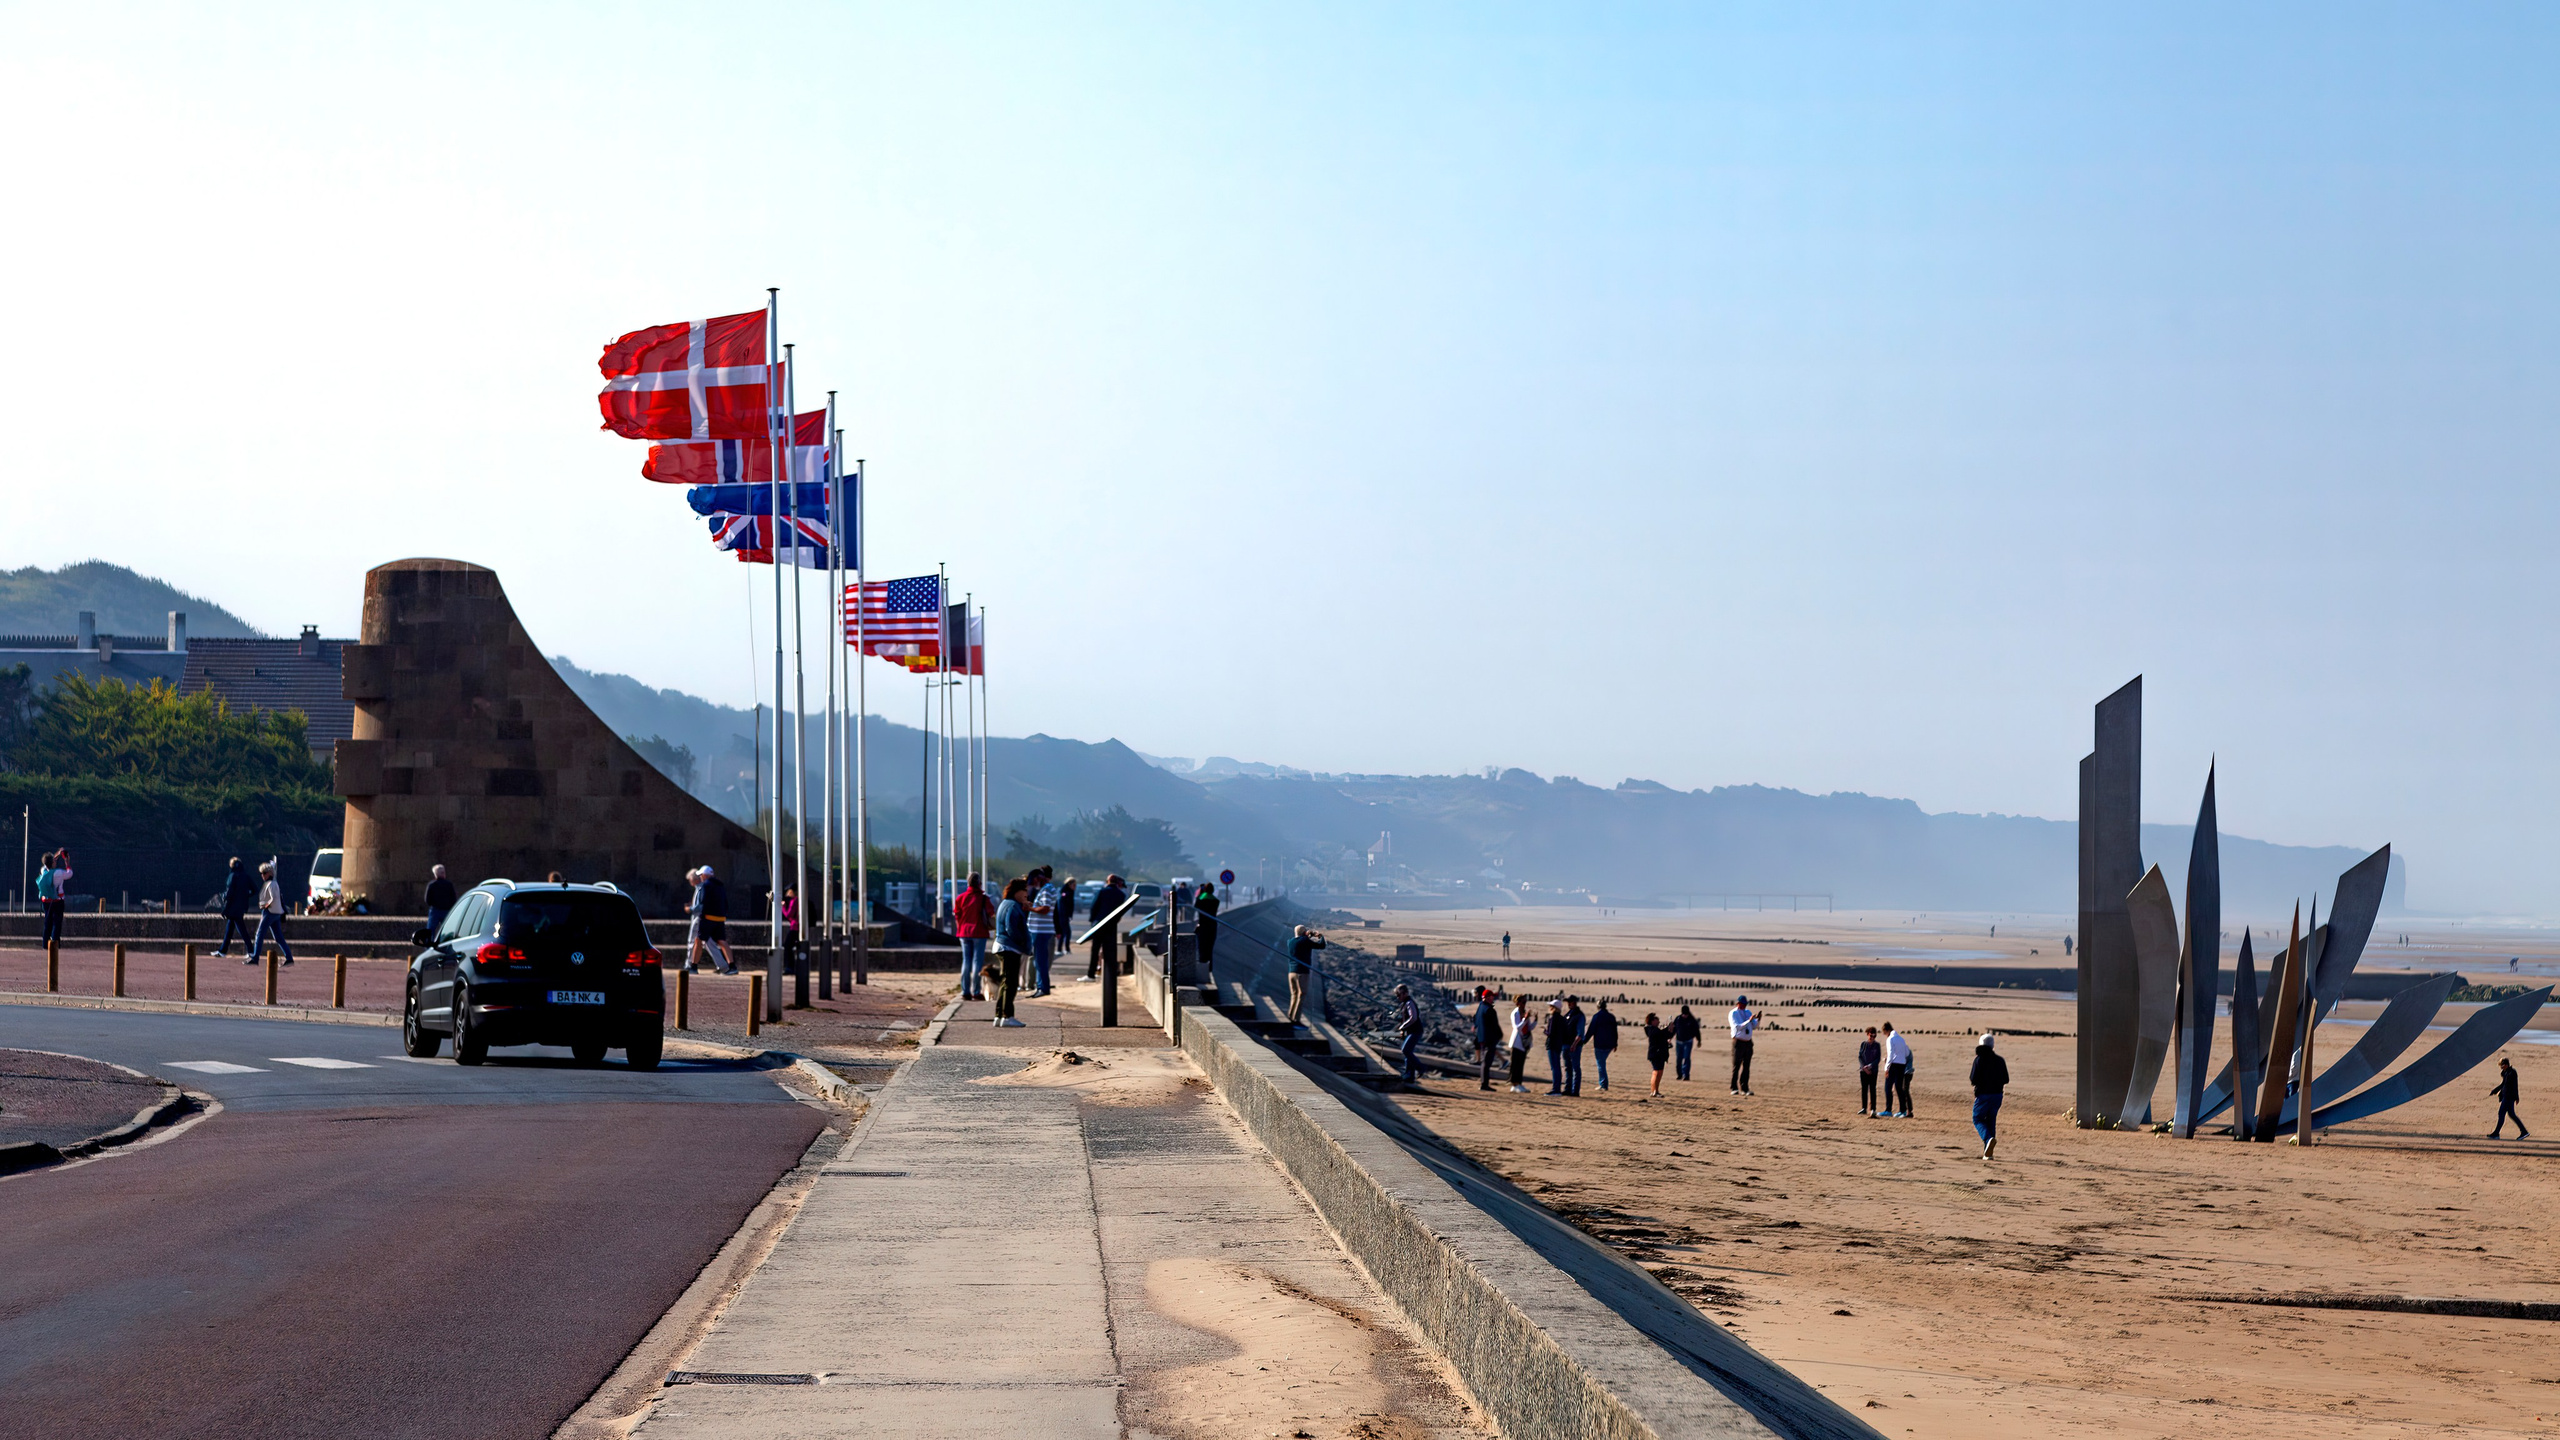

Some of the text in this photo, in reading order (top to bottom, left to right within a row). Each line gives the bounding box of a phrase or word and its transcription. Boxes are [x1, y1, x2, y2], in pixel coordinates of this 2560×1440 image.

[557, 992, 600, 1003] BA NK 4
